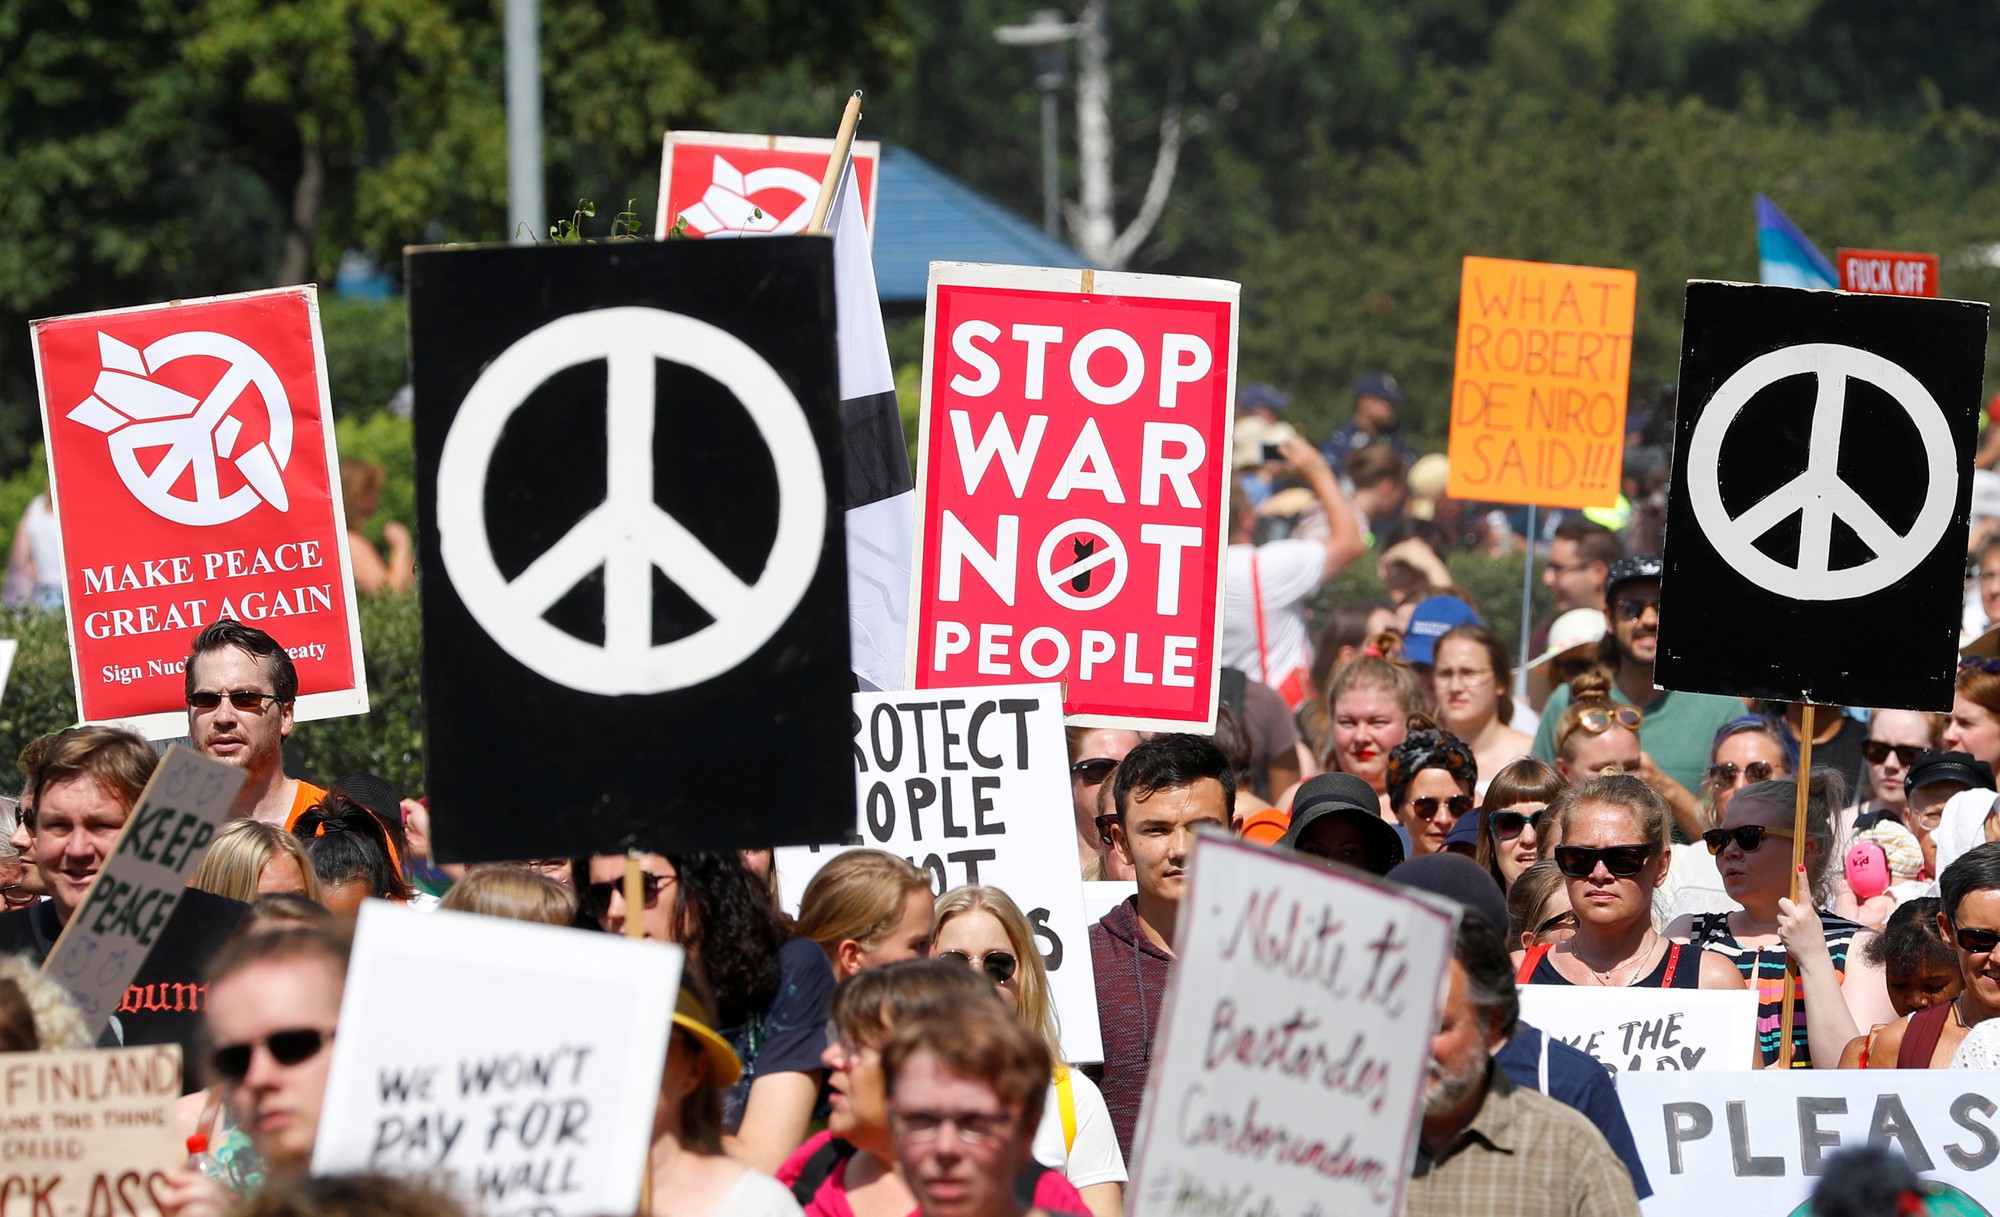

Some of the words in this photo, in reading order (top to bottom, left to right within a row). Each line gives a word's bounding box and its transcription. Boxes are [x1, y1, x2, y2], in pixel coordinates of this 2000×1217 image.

[1474, 275, 1621, 328] WHAT
[1847, 257, 1893, 292] FUCK
[1894, 260, 1927, 296] OFF
[949, 320, 1213, 408] STOP
[1466, 323, 1632, 381] ROBERT
[1457, 379, 1517, 431] DE
[1525, 387, 1617, 438] NIRO
[949, 410, 1206, 509] WAR
[1462, 434, 1616, 490] SAID!!!
[81, 556, 194, 595] MAKE
[202, 540, 323, 581] PEACE
[938, 510, 1203, 616] NOT
[84, 599, 207, 639] GREAT
[218, 584, 332, 622] AGAIN
[102, 662, 143, 685] Sign
[148, 656, 188, 677] Nuc
[283, 642, 326, 661] eaty
[934, 620, 1198, 687] PEOPLE
[852, 698, 1040, 774] OTECT
[118, 802, 214, 873] KEEP
[848, 776, 1006, 847] OPLE
[906, 848, 996, 898] OT
[77, 875, 176, 947] PEACE
[1359, 919, 1407, 1020] te
[1618, 1012, 1684, 1056] THE
[6, 1052, 178, 1107] FINLAND
[376, 1062, 439, 1105] WE
[457, 1042, 594, 1098] WON'T
[373, 1110, 463, 1165] PAY
[486, 1096, 591, 1152] FOR
[475, 1155, 583, 1199] WALL
